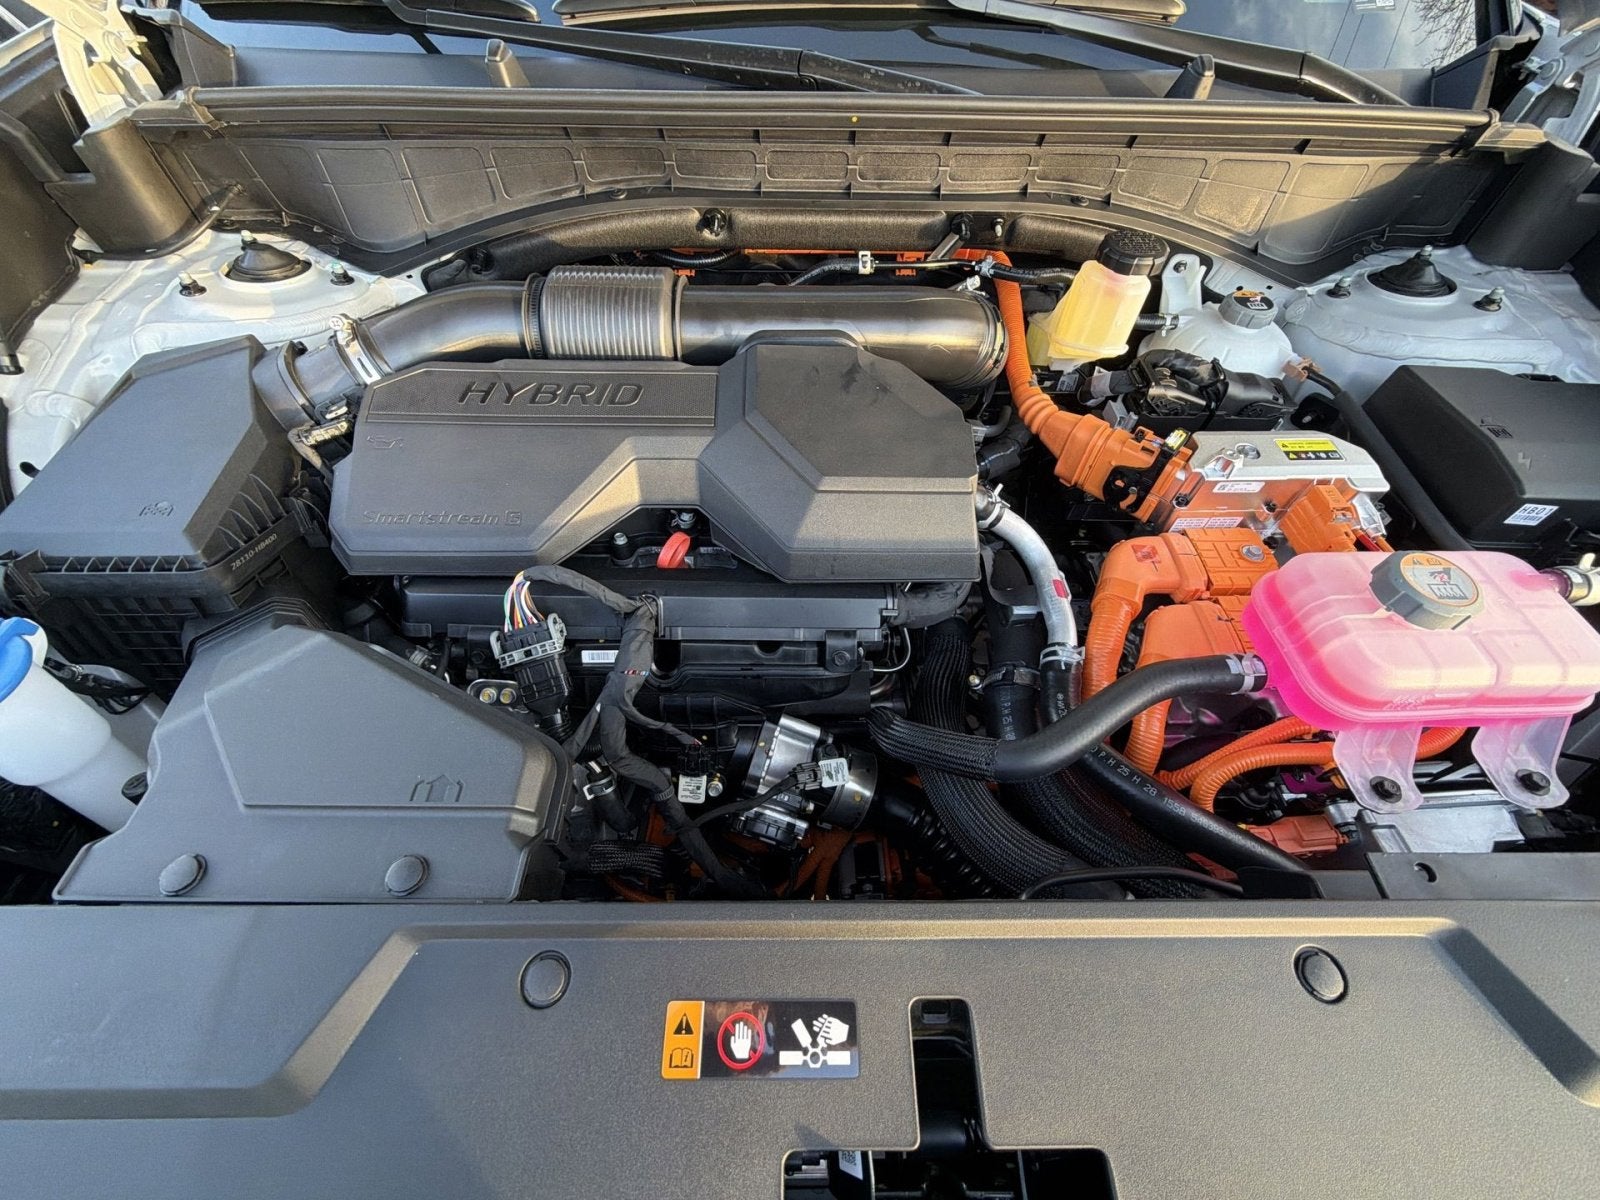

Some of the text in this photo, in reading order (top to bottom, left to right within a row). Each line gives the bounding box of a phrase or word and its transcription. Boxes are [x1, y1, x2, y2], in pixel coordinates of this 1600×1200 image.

[457, 381, 645, 407] HYBRID
[362, 510, 499, 526] Smartstream
[1117, 765, 1131, 777] 25
[1131, 775, 1142, 784] H
[1143, 783, 1158, 797] 28
